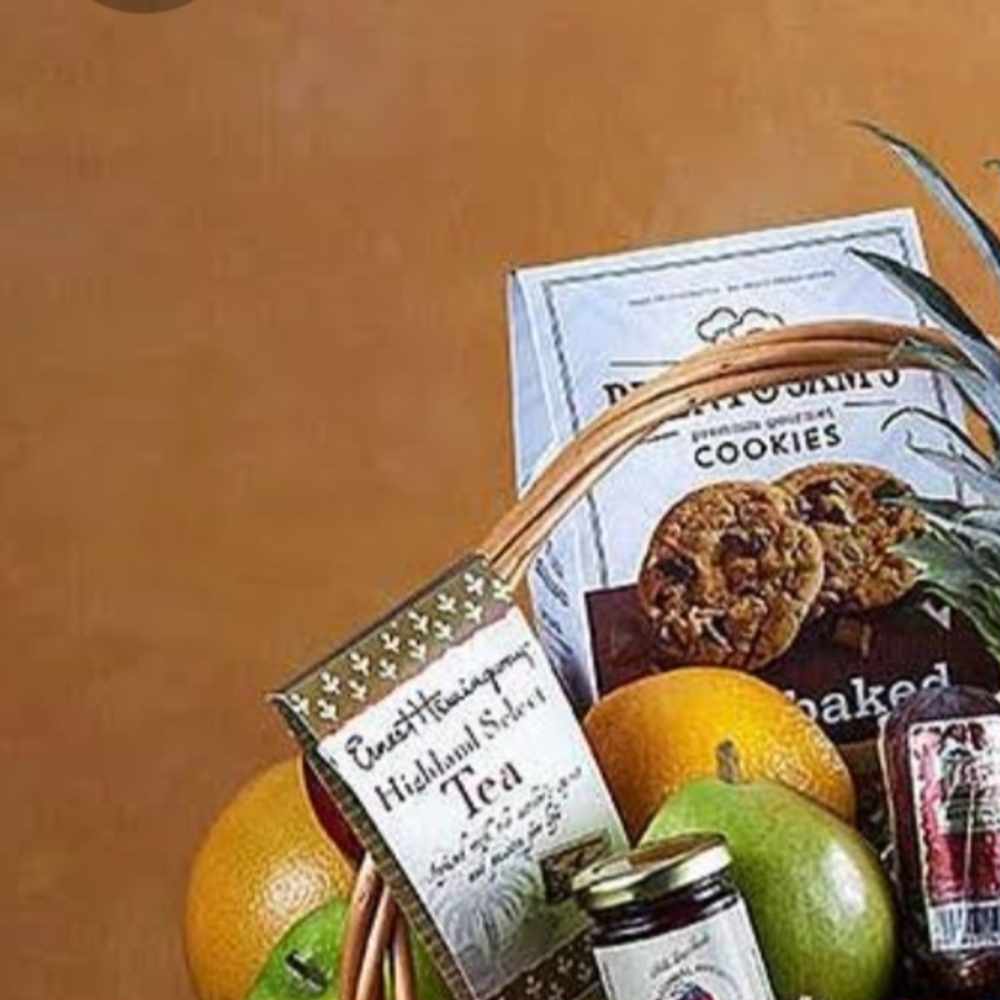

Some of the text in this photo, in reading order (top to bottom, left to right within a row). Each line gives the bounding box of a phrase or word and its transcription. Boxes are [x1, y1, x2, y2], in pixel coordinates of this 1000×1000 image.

[693, 423, 842, 469] COOKIES
[374, 686, 547, 812] Highland Select
[439, 761, 523, 820] Tea
